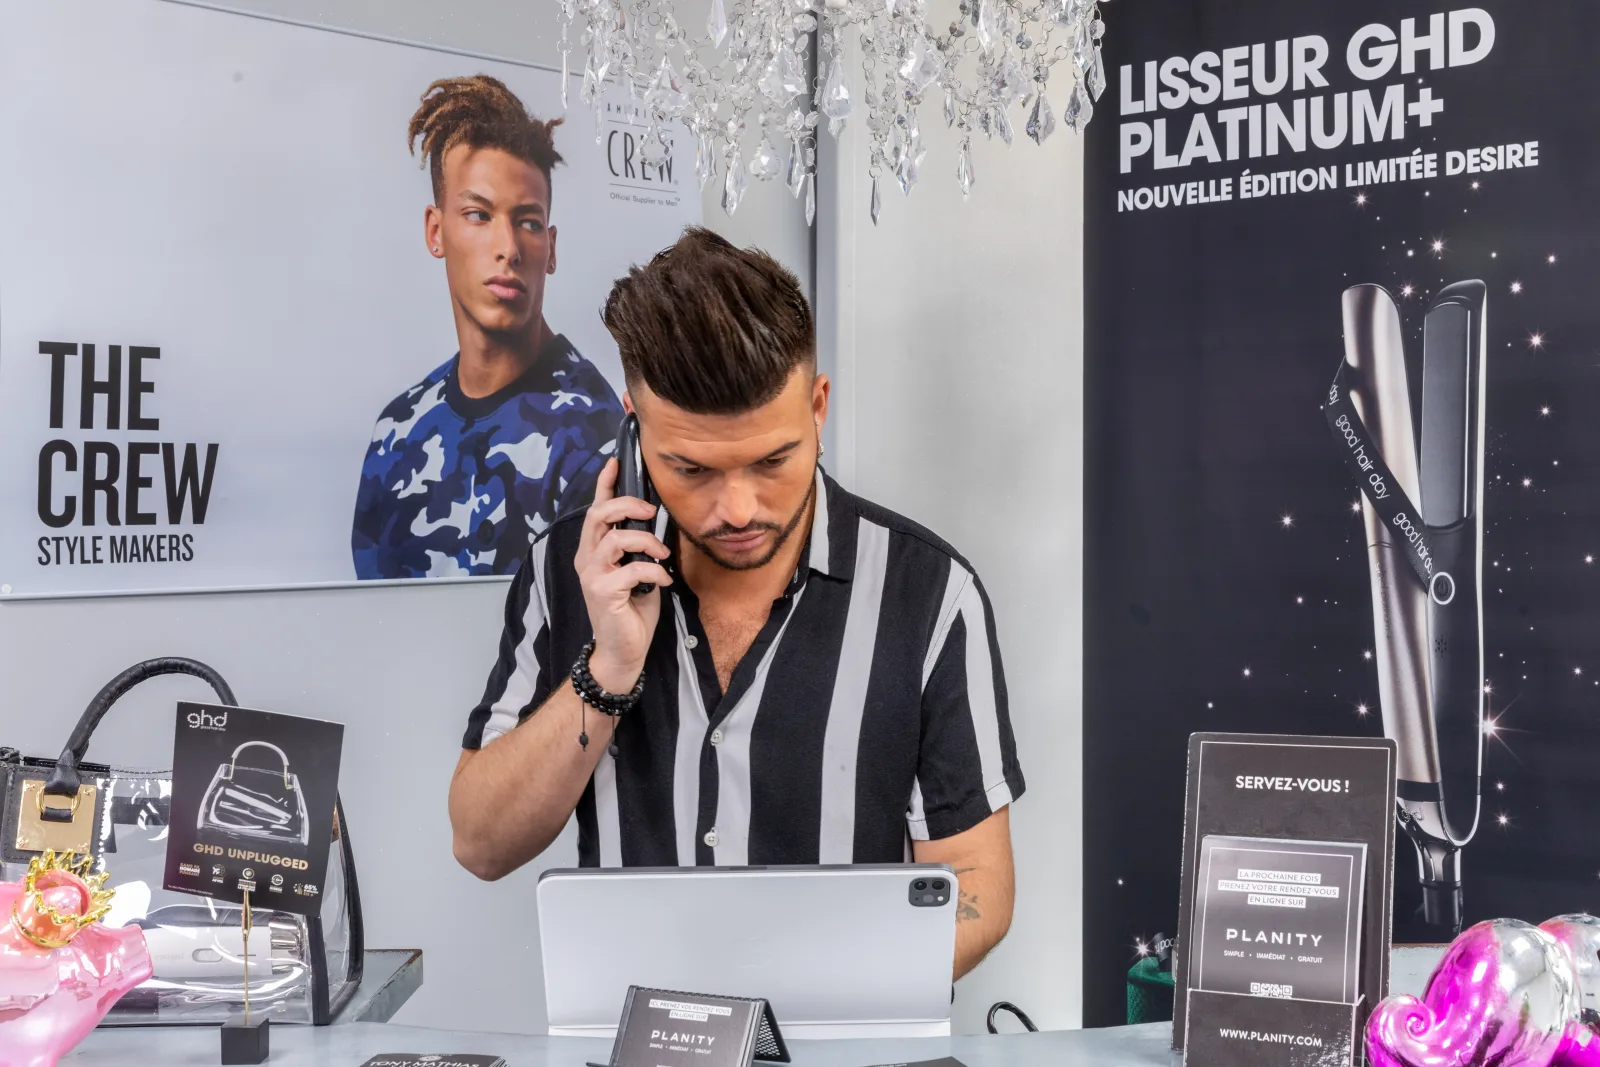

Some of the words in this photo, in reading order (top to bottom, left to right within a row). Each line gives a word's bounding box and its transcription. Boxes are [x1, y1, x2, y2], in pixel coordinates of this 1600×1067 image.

[1120, 34, 1330, 116] LISSEUR
[1346, 8, 1496, 80] GHD
[1120, 84, 1444, 174] PLATINUM+
[1118, 178, 1232, 212] NOUVELLE
[1240, 166, 1337, 199] ÉDITION
[1346, 148, 1437, 187] LIMITÉE
[1446, 141, 1538, 176] DESIRE
[610, 192, 630, 200] Official
[633, 196, 656, 204] Supplier
[38, 341, 160, 430] THE
[1336, 415, 1360, 448] good
[1353, 445, 1373, 472] hair
[1369, 474, 1390, 499] day
[38, 439, 219, 528] CREW
[1393, 513, 1421, 543] good
[38, 536, 103, 565] STYLE
[110, 534, 194, 563] MAKERS
[187, 710, 227, 728] ghd
[1236, 776, 1341, 792] SERVEZ-VOUS
[193, 843, 224, 856] GHD
[228, 848, 308, 870] UNPLUGGED
[1251, 872, 1298, 880] PROCHAINE
[1300, 874, 1319, 882] FOIS
[1252, 884, 1278, 892] VOTRE
[1280, 886, 1337, 896] RENDEZ-VOUS
[1262, 896, 1286, 904] LIGNE
[1288, 898, 1304, 906] SUR
[1226, 928, 1322, 947] PLANITY
[1224, 950, 1244, 958] SIMPLE
[651, 1030, 715, 1046] PLANITY
[1220, 1028, 1322, 1047] WWW.PLANITY.COM
